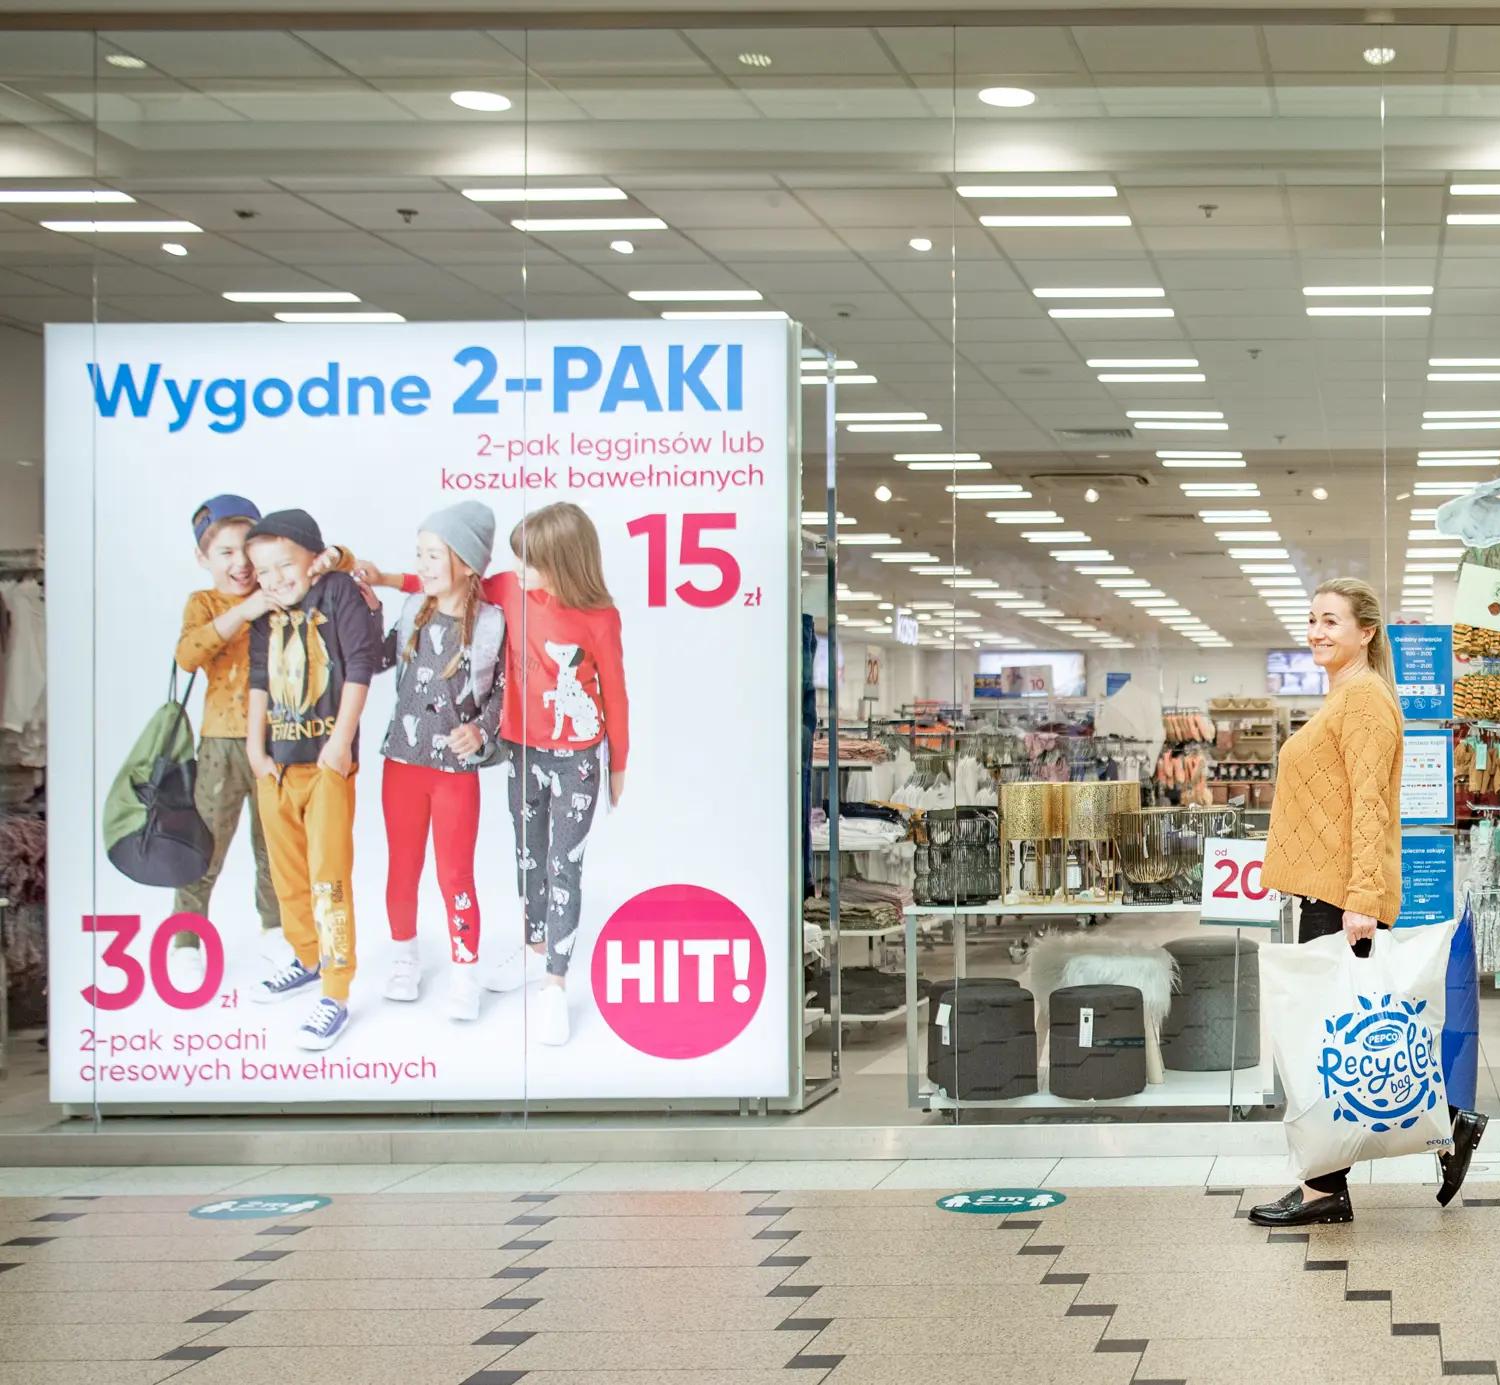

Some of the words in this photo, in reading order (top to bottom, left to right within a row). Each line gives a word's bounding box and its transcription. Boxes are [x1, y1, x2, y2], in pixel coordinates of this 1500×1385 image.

[86, 362, 431, 434] Wygodne
[452, 344, 743, 415] 2-PAKI
[476, 433, 560, 462] 2-pak
[569, 432, 713, 464] legginsów
[723, 431, 765, 455] lub
[440, 464, 560, 491] koszulek
[568, 463, 765, 493] bawełnianych
[626, 512, 742, 609] 15
[743, 586, 762, 607] zł
[1030, 678, 1045, 690] 10
[1214, 847, 1228, 856] od
[1212, 858, 1270, 900] 20
[1268, 892, 1277, 901] zł
[80, 911, 225, 1011] 30
[220, 988, 238, 1008] zł
[605, 937, 752, 1005] HIT!
[79, 1028, 163, 1058] 2-pak
[173, 1027, 267, 1057] spodni
[1368, 1032, 1399, 1044] PEPCO
[241, 1055, 437, 1085] bawełnianych
[1390, 1073, 1414, 1103] bag
